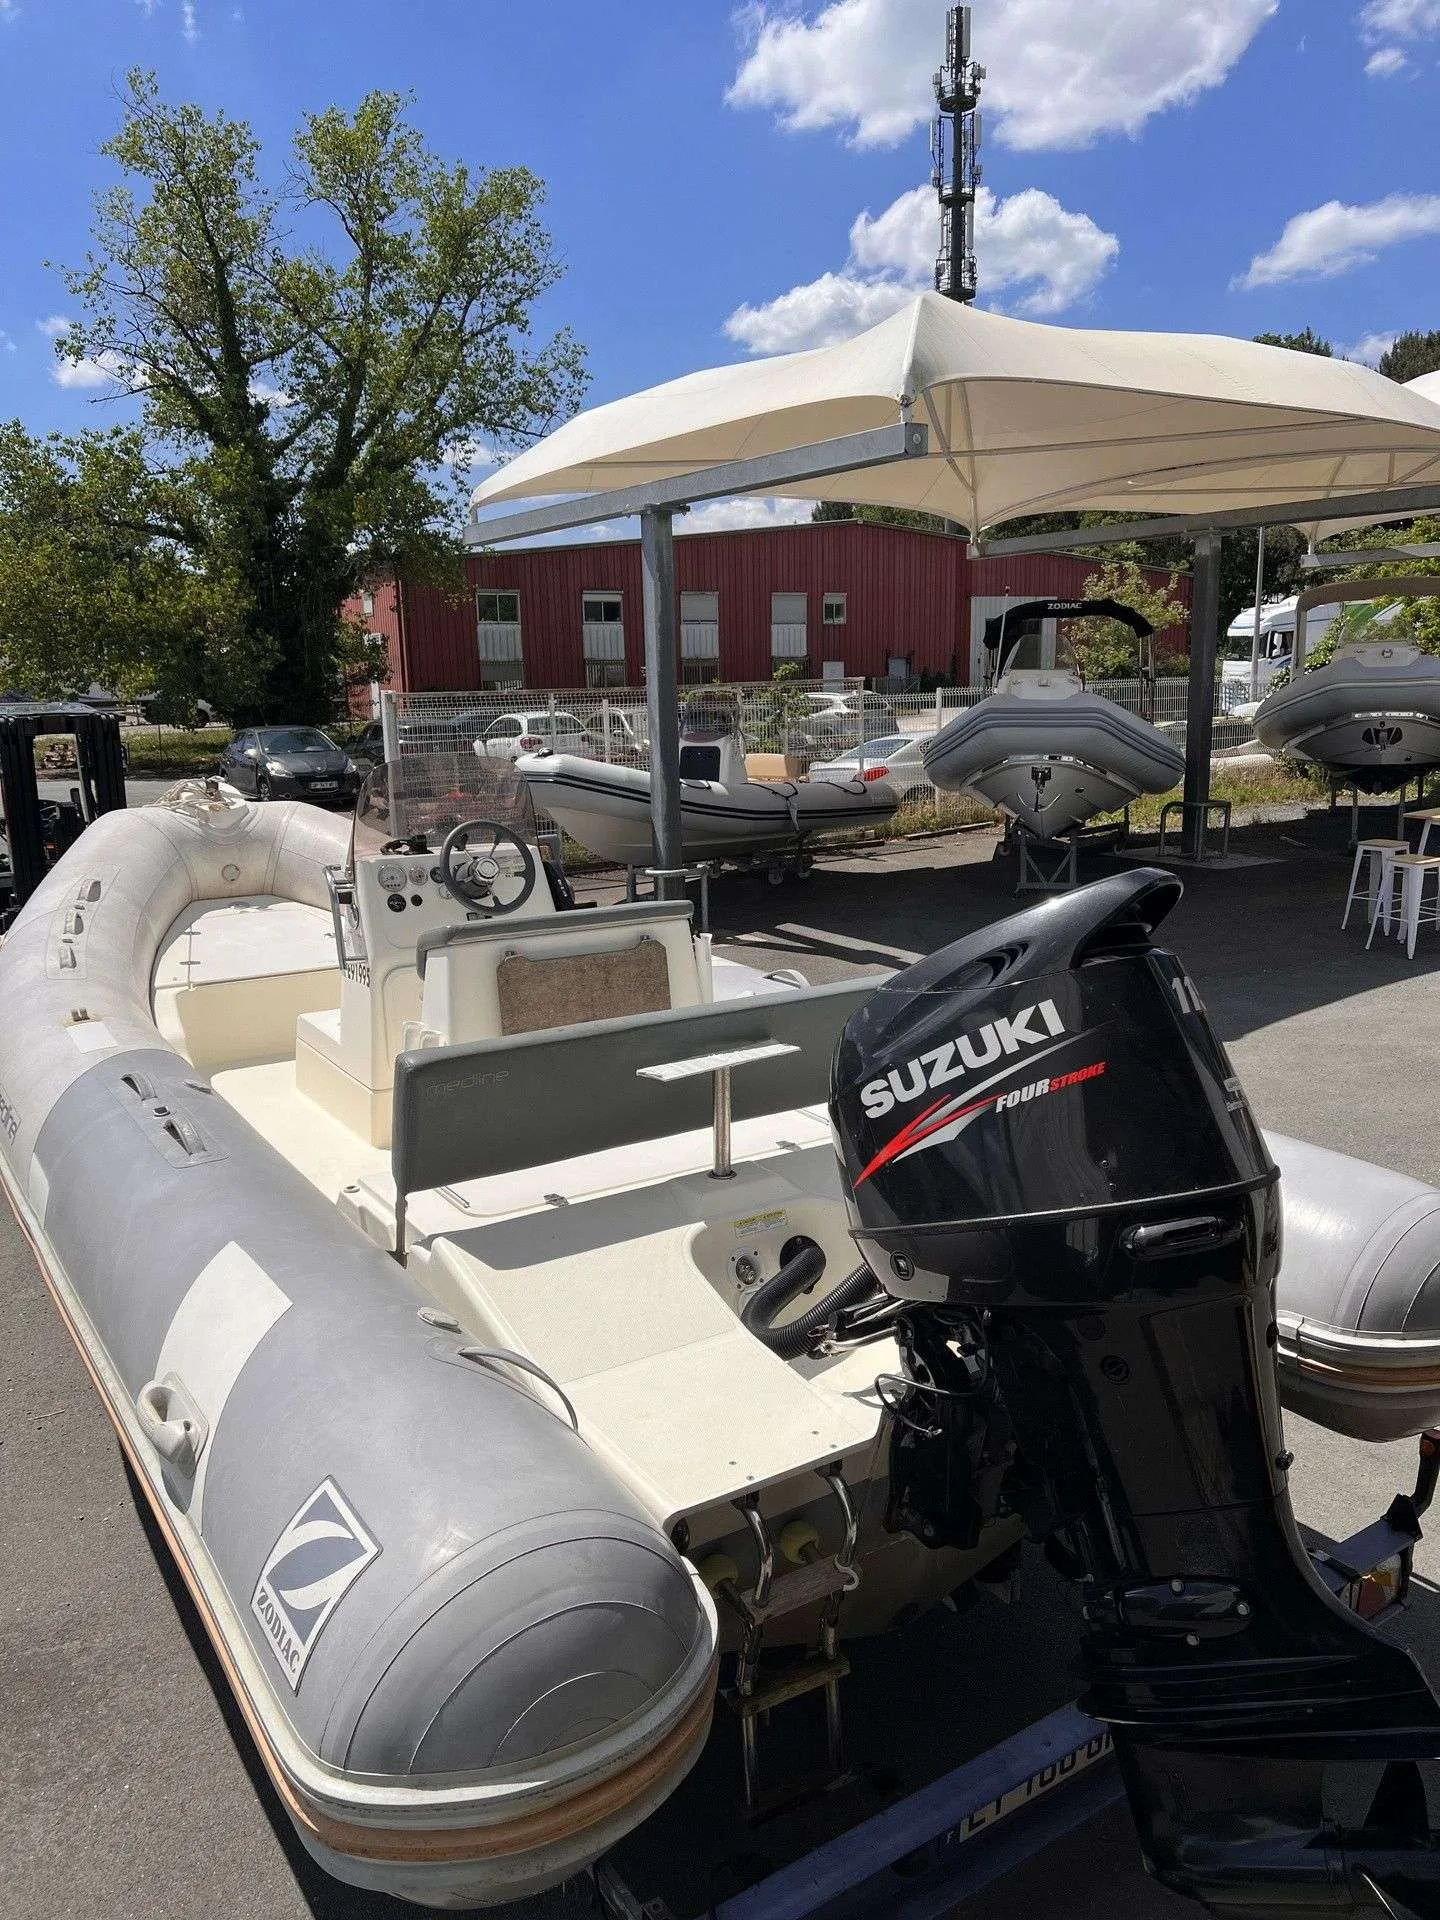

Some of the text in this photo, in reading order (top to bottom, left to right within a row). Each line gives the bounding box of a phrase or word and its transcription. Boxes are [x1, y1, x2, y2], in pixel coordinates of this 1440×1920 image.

[1047, 602, 1083, 610] ZODIAC
[860, 998, 1066, 1119] SUZUKI
[256, 1585, 300, 1674] ZODIAC
